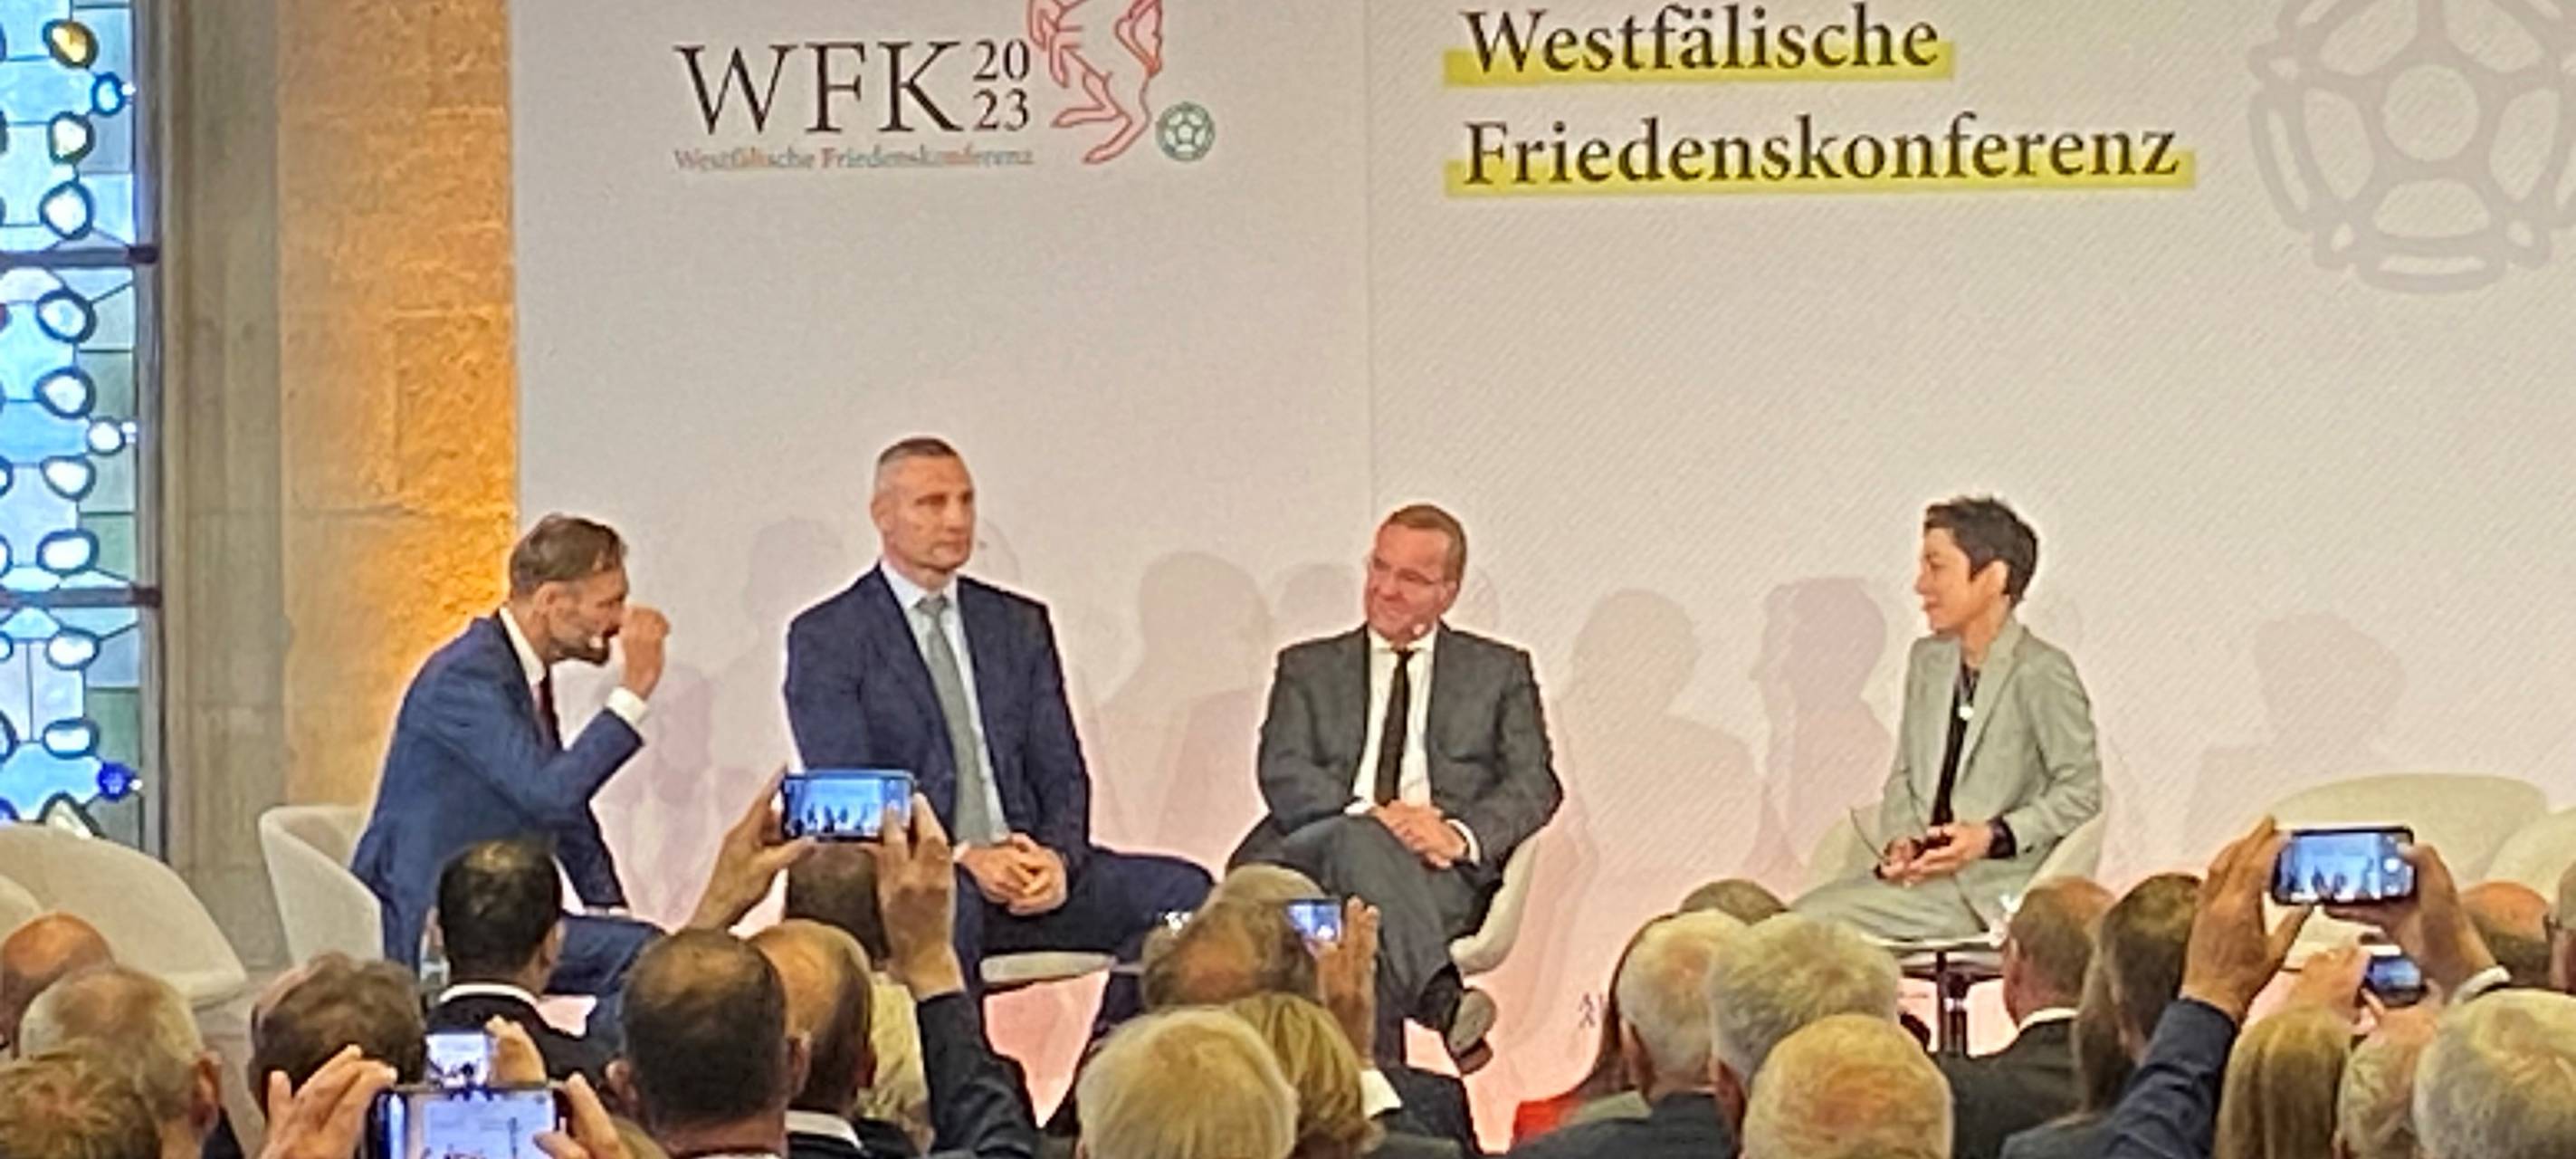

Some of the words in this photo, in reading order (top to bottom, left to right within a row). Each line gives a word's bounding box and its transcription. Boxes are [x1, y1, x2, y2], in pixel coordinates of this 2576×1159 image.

[973, 39, 1030, 81] 20
[1465, 2, 1938, 72] Westfälische
[673, 41, 964, 135] WFK
[973, 88, 1030, 131] 23
[1466, 111, 2179, 185] Friedenskonferenz
